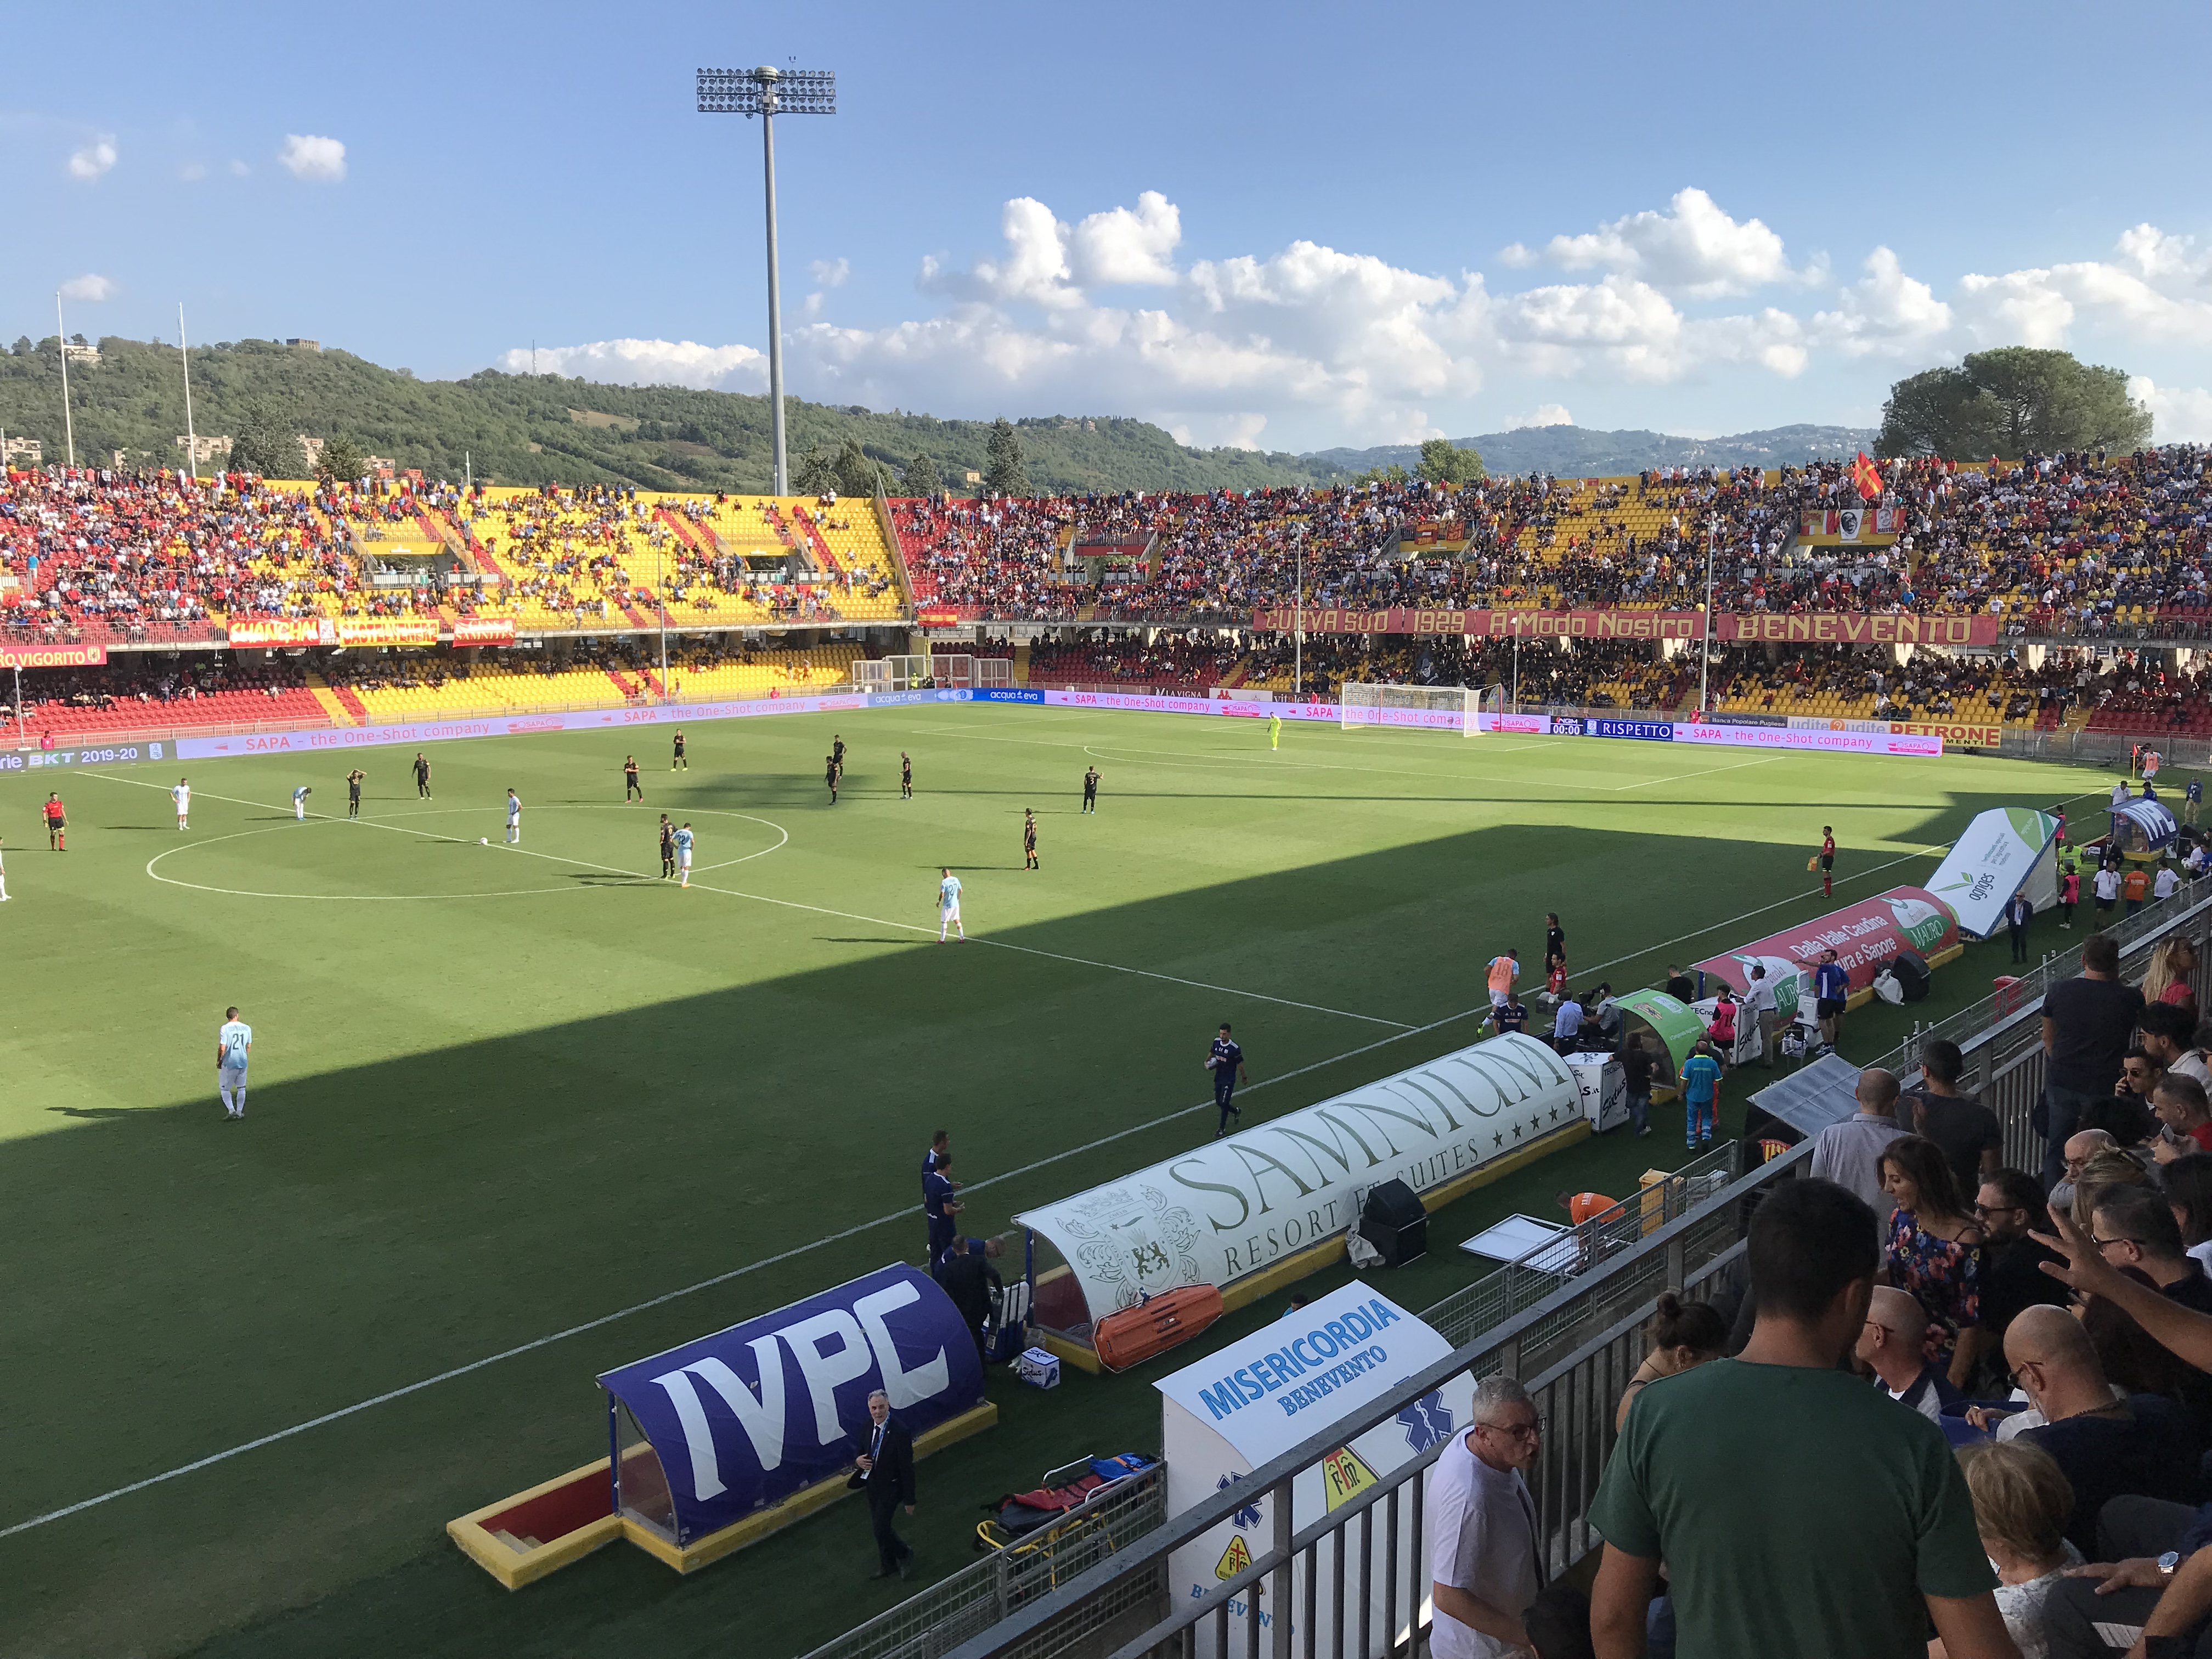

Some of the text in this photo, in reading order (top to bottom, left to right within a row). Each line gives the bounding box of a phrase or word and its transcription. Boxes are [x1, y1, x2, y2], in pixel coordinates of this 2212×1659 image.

[1345, 611, 1389, 632] SUD
[1414, 611, 1466, 633] 1929
[1489, 612, 1694, 637] A Modo Nostro
[1736, 614, 1971, 643] BENEVENTO
[18, 651, 85, 666] VIGORITO
[875, 696, 900, 705] acqua
[990, 691, 1038, 701] acqua eva
[1075, 695, 1097, 704] SAPA
[1107, 696, 1121, 706] the
[1124, 697, 1165, 708] One-Shot
[1169, 700, 1210, 713] company
[1306, 696, 1338, 705] vtale
[624, 710, 657, 722] SAPA
[672, 708, 692, 719] the
[697, 704, 752, 716] One-Shot
[755, 701, 805, 713] company
[1306, 707, 1333, 718] SAPA
[1346, 708, 1363, 719] the
[1368, 710, 1418, 723] One-Shot
[1553, 724, 1581, 736] 00:00
[1603, 723, 1671, 738] RISPETTO
[1791, 718, 1829, 730] udite
[1891, 723, 2000, 746] PETRONE
[246, 736, 291, 751] SAPA
[311, 733, 337, 746] the
[345, 728, 417, 743] One-Shot
[424, 723, 490, 737] company
[1693, 729, 1722, 740] SAPA
[1735, 730, 1753, 740] the
[1759, 732, 1813, 744] One-Shot
[1818, 736, 1873, 749] company
[29, 752, 75, 766] BKT
[81, 747, 138, 763] 2019-20
[1090, 777, 1094, 785] 3
[1789, 916, 1889, 958] Dalla Valle Caudina
[1910, 919, 1944, 949] MAURO
[1861, 937, 1897, 961] Sapore
[232, 1033, 244, 1050] 21
[1169, 1036, 1569, 1233] SAMNIUM
[1224, 1200, 1339, 1278] RESORT
[1397, 1137, 1480, 1194] SUITES
[1198, 1299, 1401, 1421] MISERICORDIA
[650, 1279, 950, 1502] IVPC
[1277, 1345, 1388, 1417] BENEVENTO
